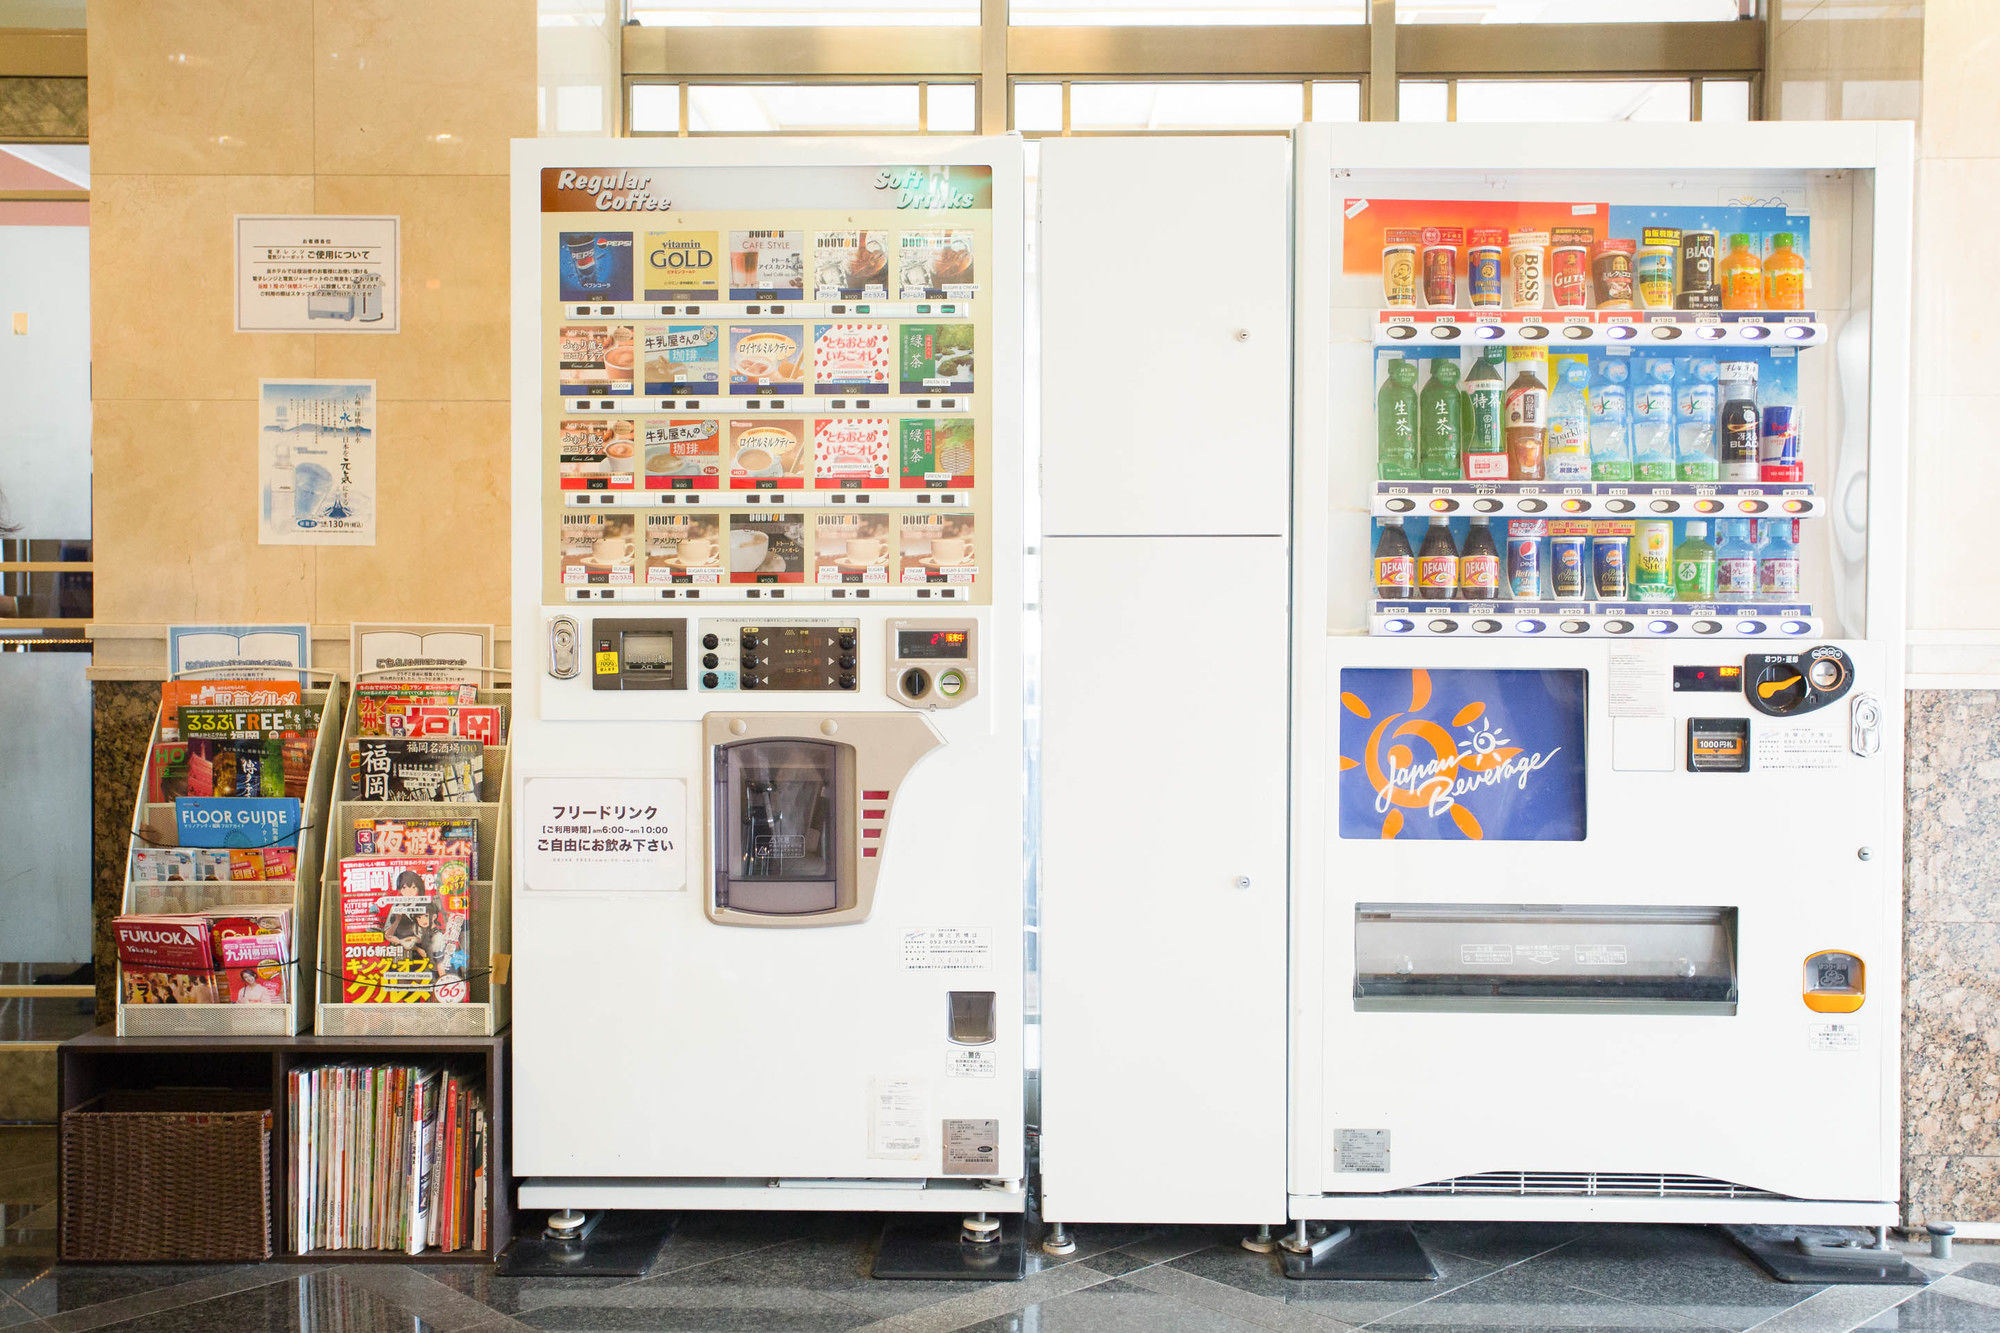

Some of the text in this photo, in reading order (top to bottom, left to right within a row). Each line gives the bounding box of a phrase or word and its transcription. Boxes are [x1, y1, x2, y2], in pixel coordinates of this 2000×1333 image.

[874, 168, 924, 190] Soft
[557, 169, 672, 211] Regular Coffee
[749, 230, 785, 238] DOUTOR
[1645, 229, 1681, 239] 自販機限定
[662, 239, 701, 250] vitamin
[769, 241, 790, 249] STYLE
[817, 238, 858, 248] DOUTOR
[307, 250, 371, 260] ご使用について
[650, 250, 713, 269] GOLD
[1525, 254, 1539, 303] BOSS
[645, 333, 700, 350] 牛乳屋さんの
[739, 342, 796, 354] ロイヤルミルクティー
[825, 337, 878, 349] とちおとめ
[672, 350, 699, 362] 珈琲
[826, 350, 878, 362] いちごオレ
[910, 334, 924, 369] 緑茶
[1394, 400, 1411, 435] 生茶
[1435, 399, 1452, 436] 生茶
[646, 427, 701, 443] 牛乳屋さんの
[825, 431, 877, 443] とちおとめ
[673, 443, 699, 455] 珈琲
[740, 436, 796, 449] ロイヤルミルクティー
[909, 428, 924, 464] 緑茶
[826, 445, 878, 457] いちごオレ
[563, 515, 604, 525] DOUTOR
[648, 515, 689, 525] DOUTOR
[750, 514, 785, 522] DOUTOR
[818, 515, 858, 525] DOUTOR
[903, 515, 943, 525] DOUTOR
[1681, 564, 1694, 579] 茶
[1719, 667, 1740, 677] 販売中
[361, 697, 378, 730] 九州
[187, 713, 285, 731] るるぶ FREE
[1699, 740, 1734, 749] 1000円札
[361, 743, 392, 801] 福岡
[1375, 746, 1562, 818] Japan Beverage
[182, 810, 287, 824] FLOOR GUIDE
[552, 805, 658, 820] フリードリンク
[537, 838, 674, 852] ご自由にお飲み下さい
[119, 929, 195, 946] FUKUOKA
[225, 949, 252, 962] 九州
[345, 946, 404, 958] 2016新店!!
[439, 982, 460, 998] 66
